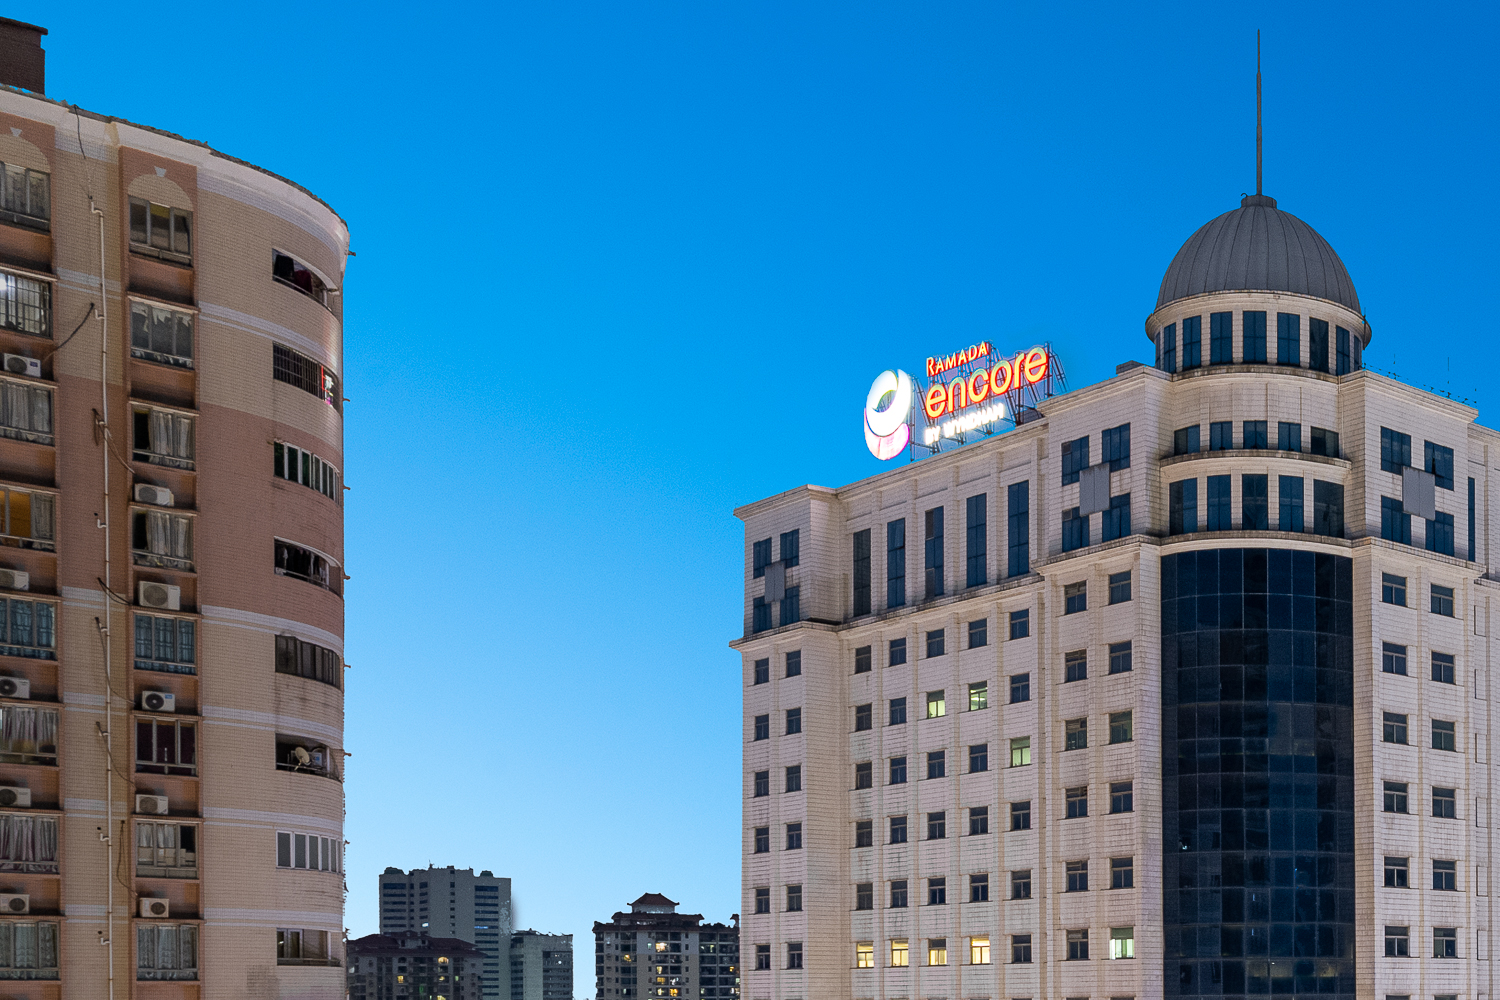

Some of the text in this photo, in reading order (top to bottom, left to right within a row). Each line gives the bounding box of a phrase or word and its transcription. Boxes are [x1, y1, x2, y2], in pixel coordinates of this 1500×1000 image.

[926, 340, 989, 377] RAMADA
[925, 346, 1049, 419] encore
[924, 402, 1004, 445] BY WYNDHAM
